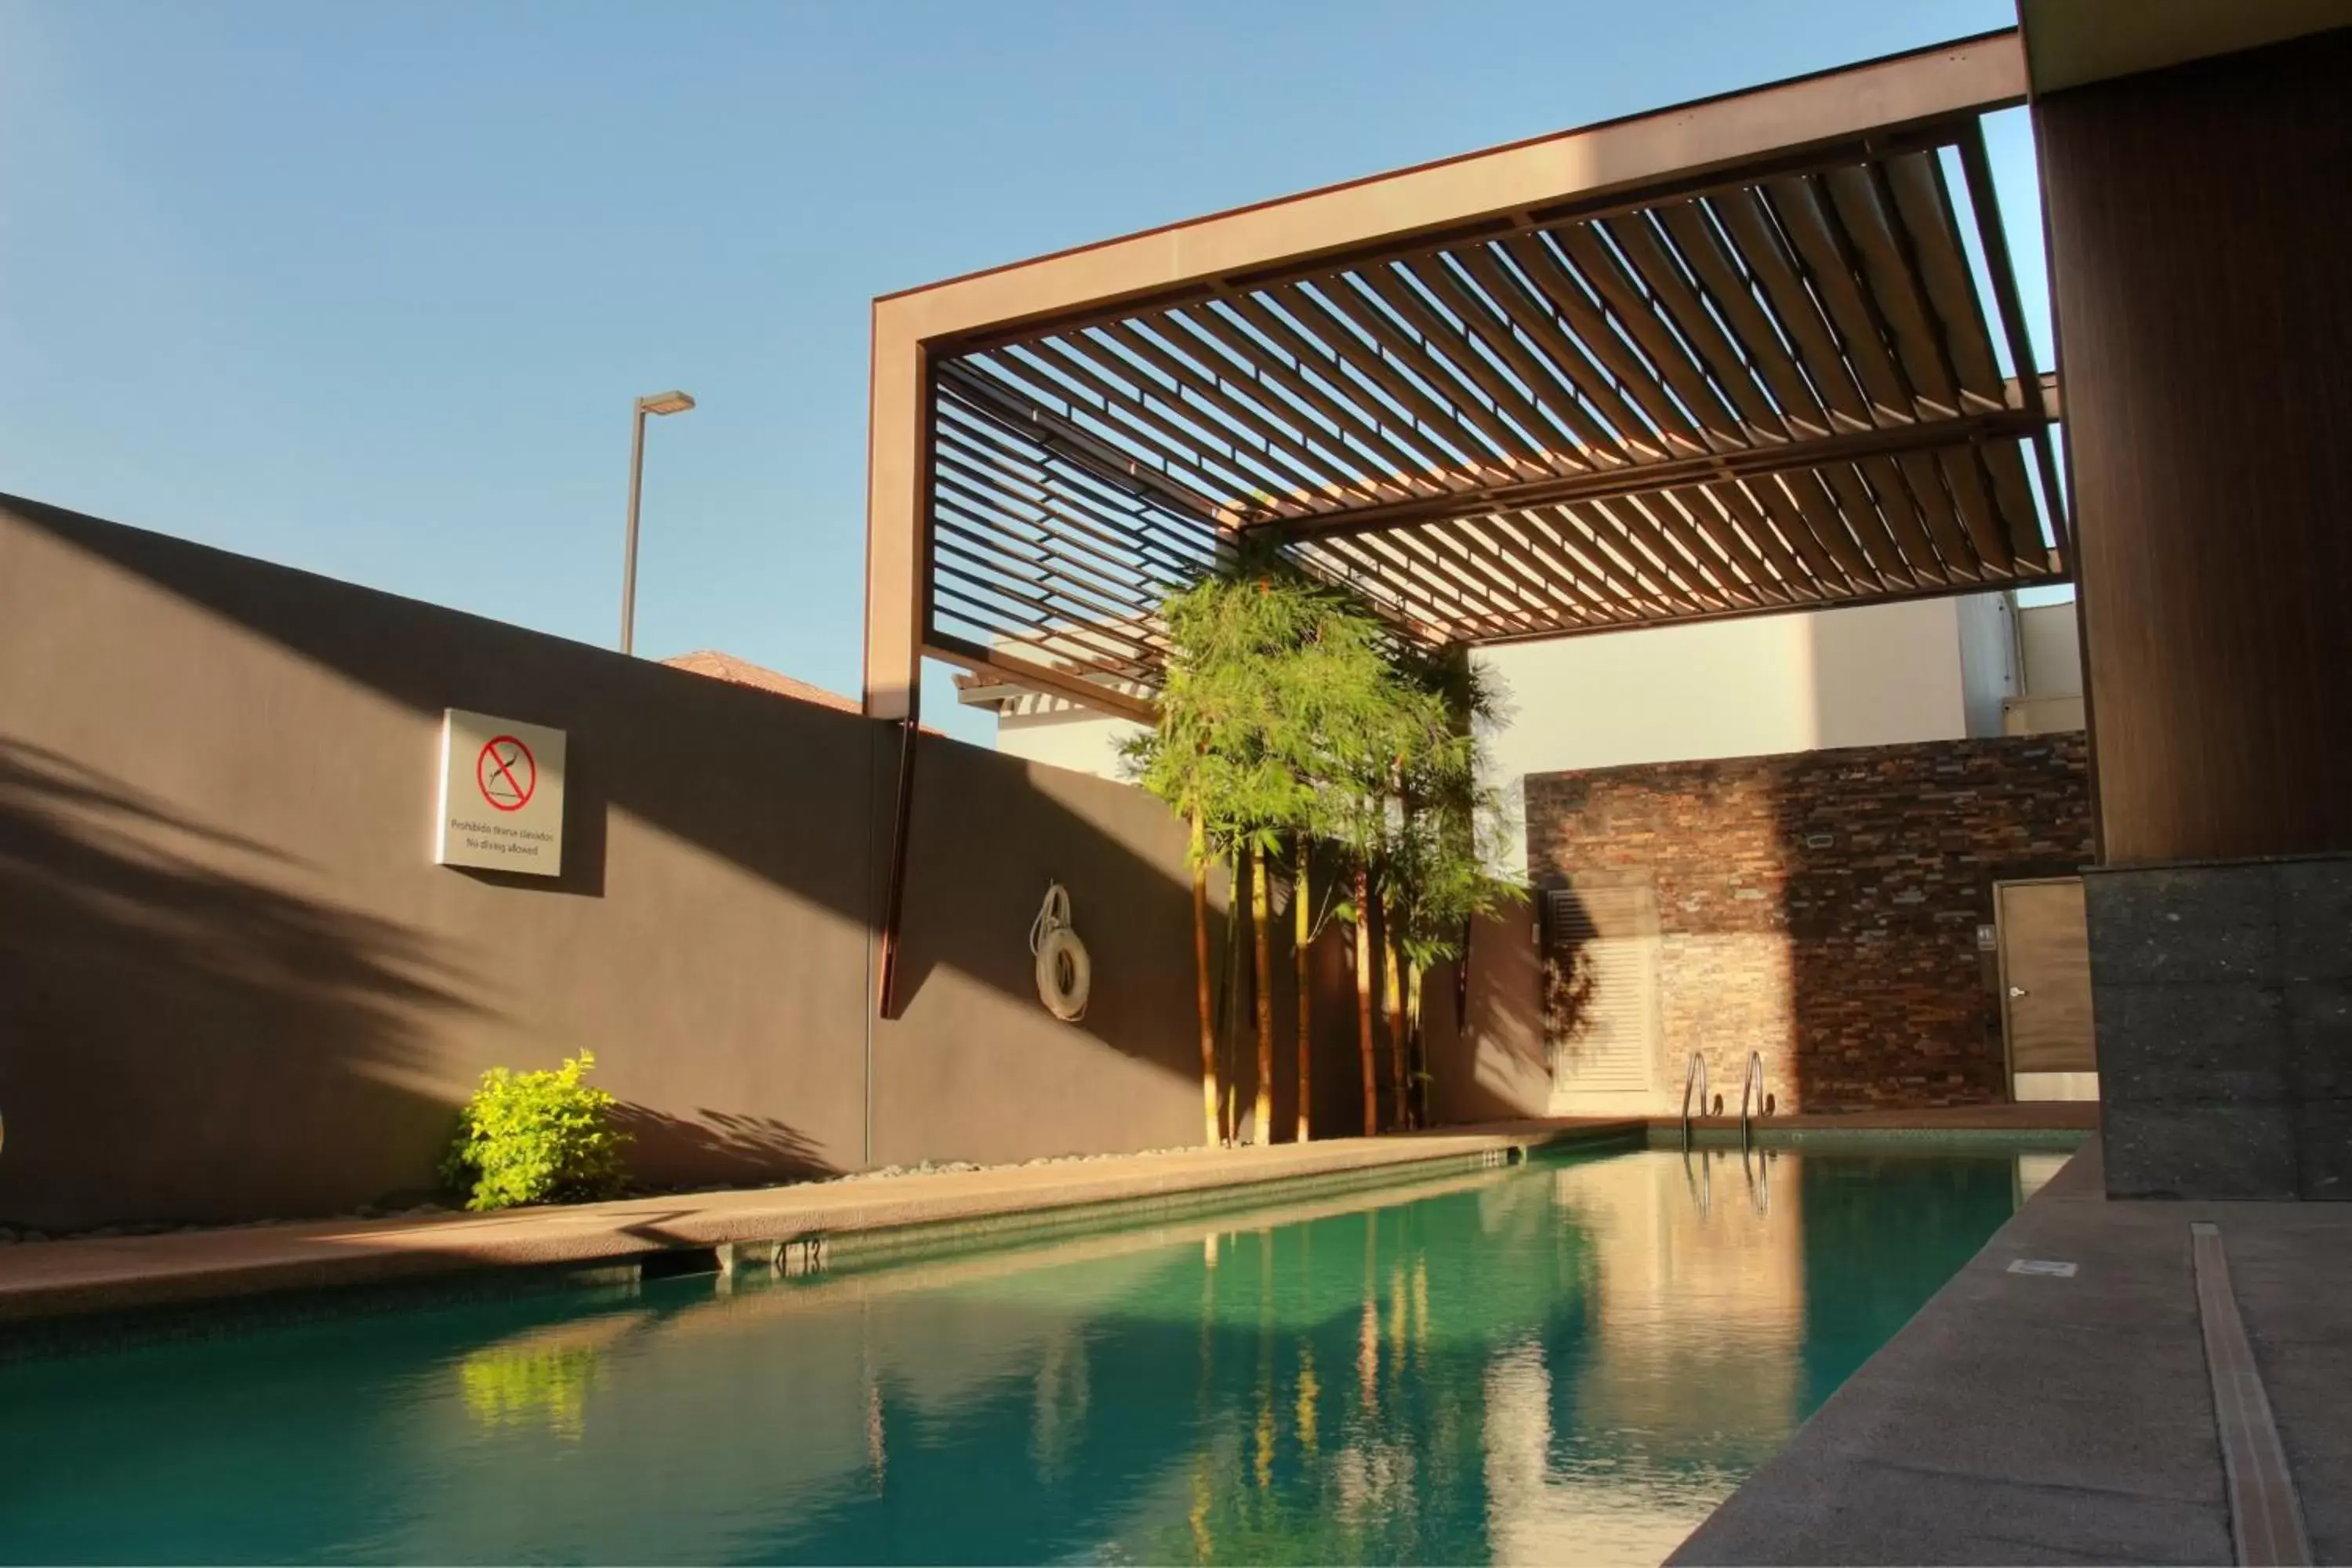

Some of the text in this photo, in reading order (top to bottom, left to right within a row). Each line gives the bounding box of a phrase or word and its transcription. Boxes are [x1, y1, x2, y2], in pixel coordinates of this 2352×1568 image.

[451, 819, 492, 833] Prohibido
[466, 837, 539, 855] No diving allowed
